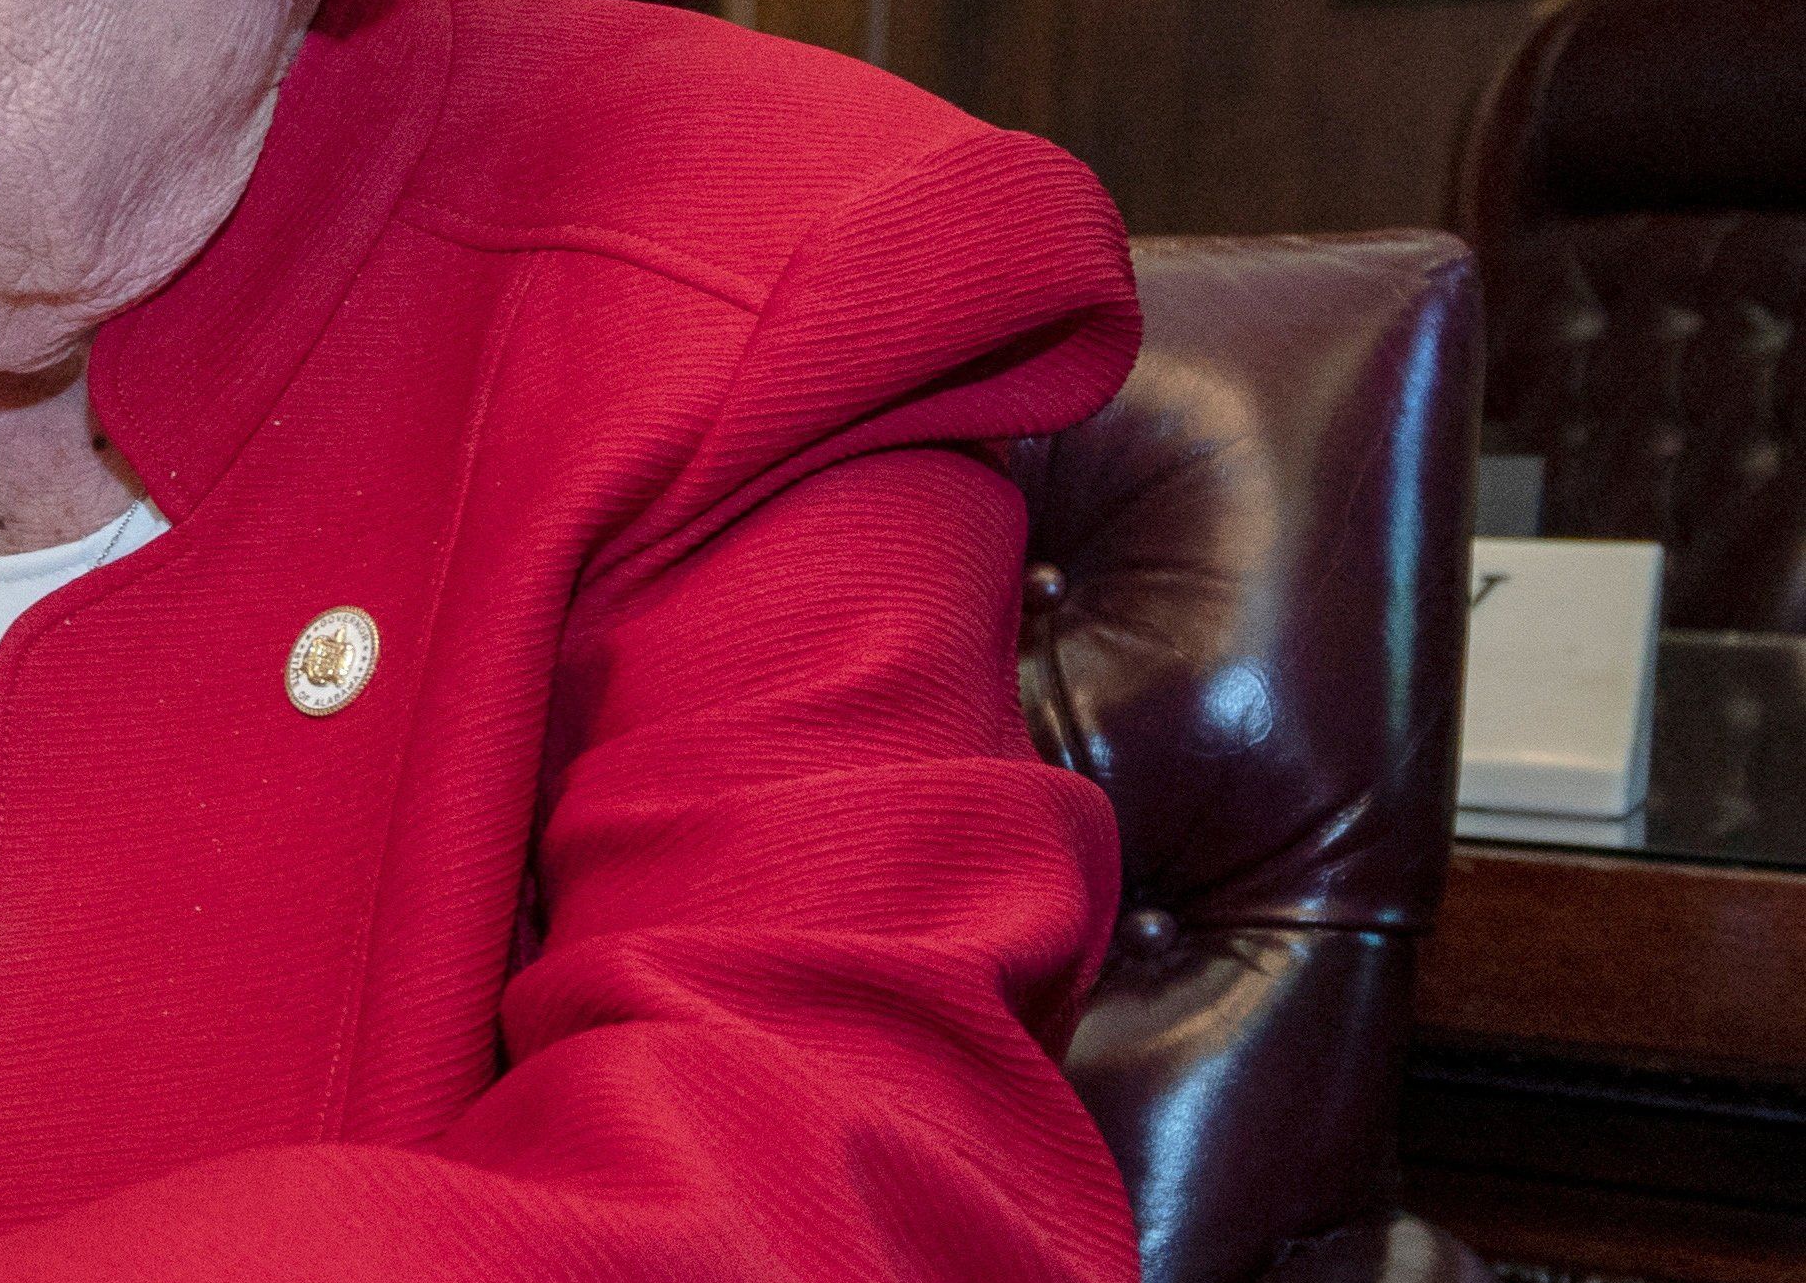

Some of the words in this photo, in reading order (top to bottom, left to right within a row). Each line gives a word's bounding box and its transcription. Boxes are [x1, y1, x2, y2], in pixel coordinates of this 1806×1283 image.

[319, 613, 371, 642] GOVERNOR
[297, 690, 311, 703] OF
[314, 676, 361, 706] ALABAMA
